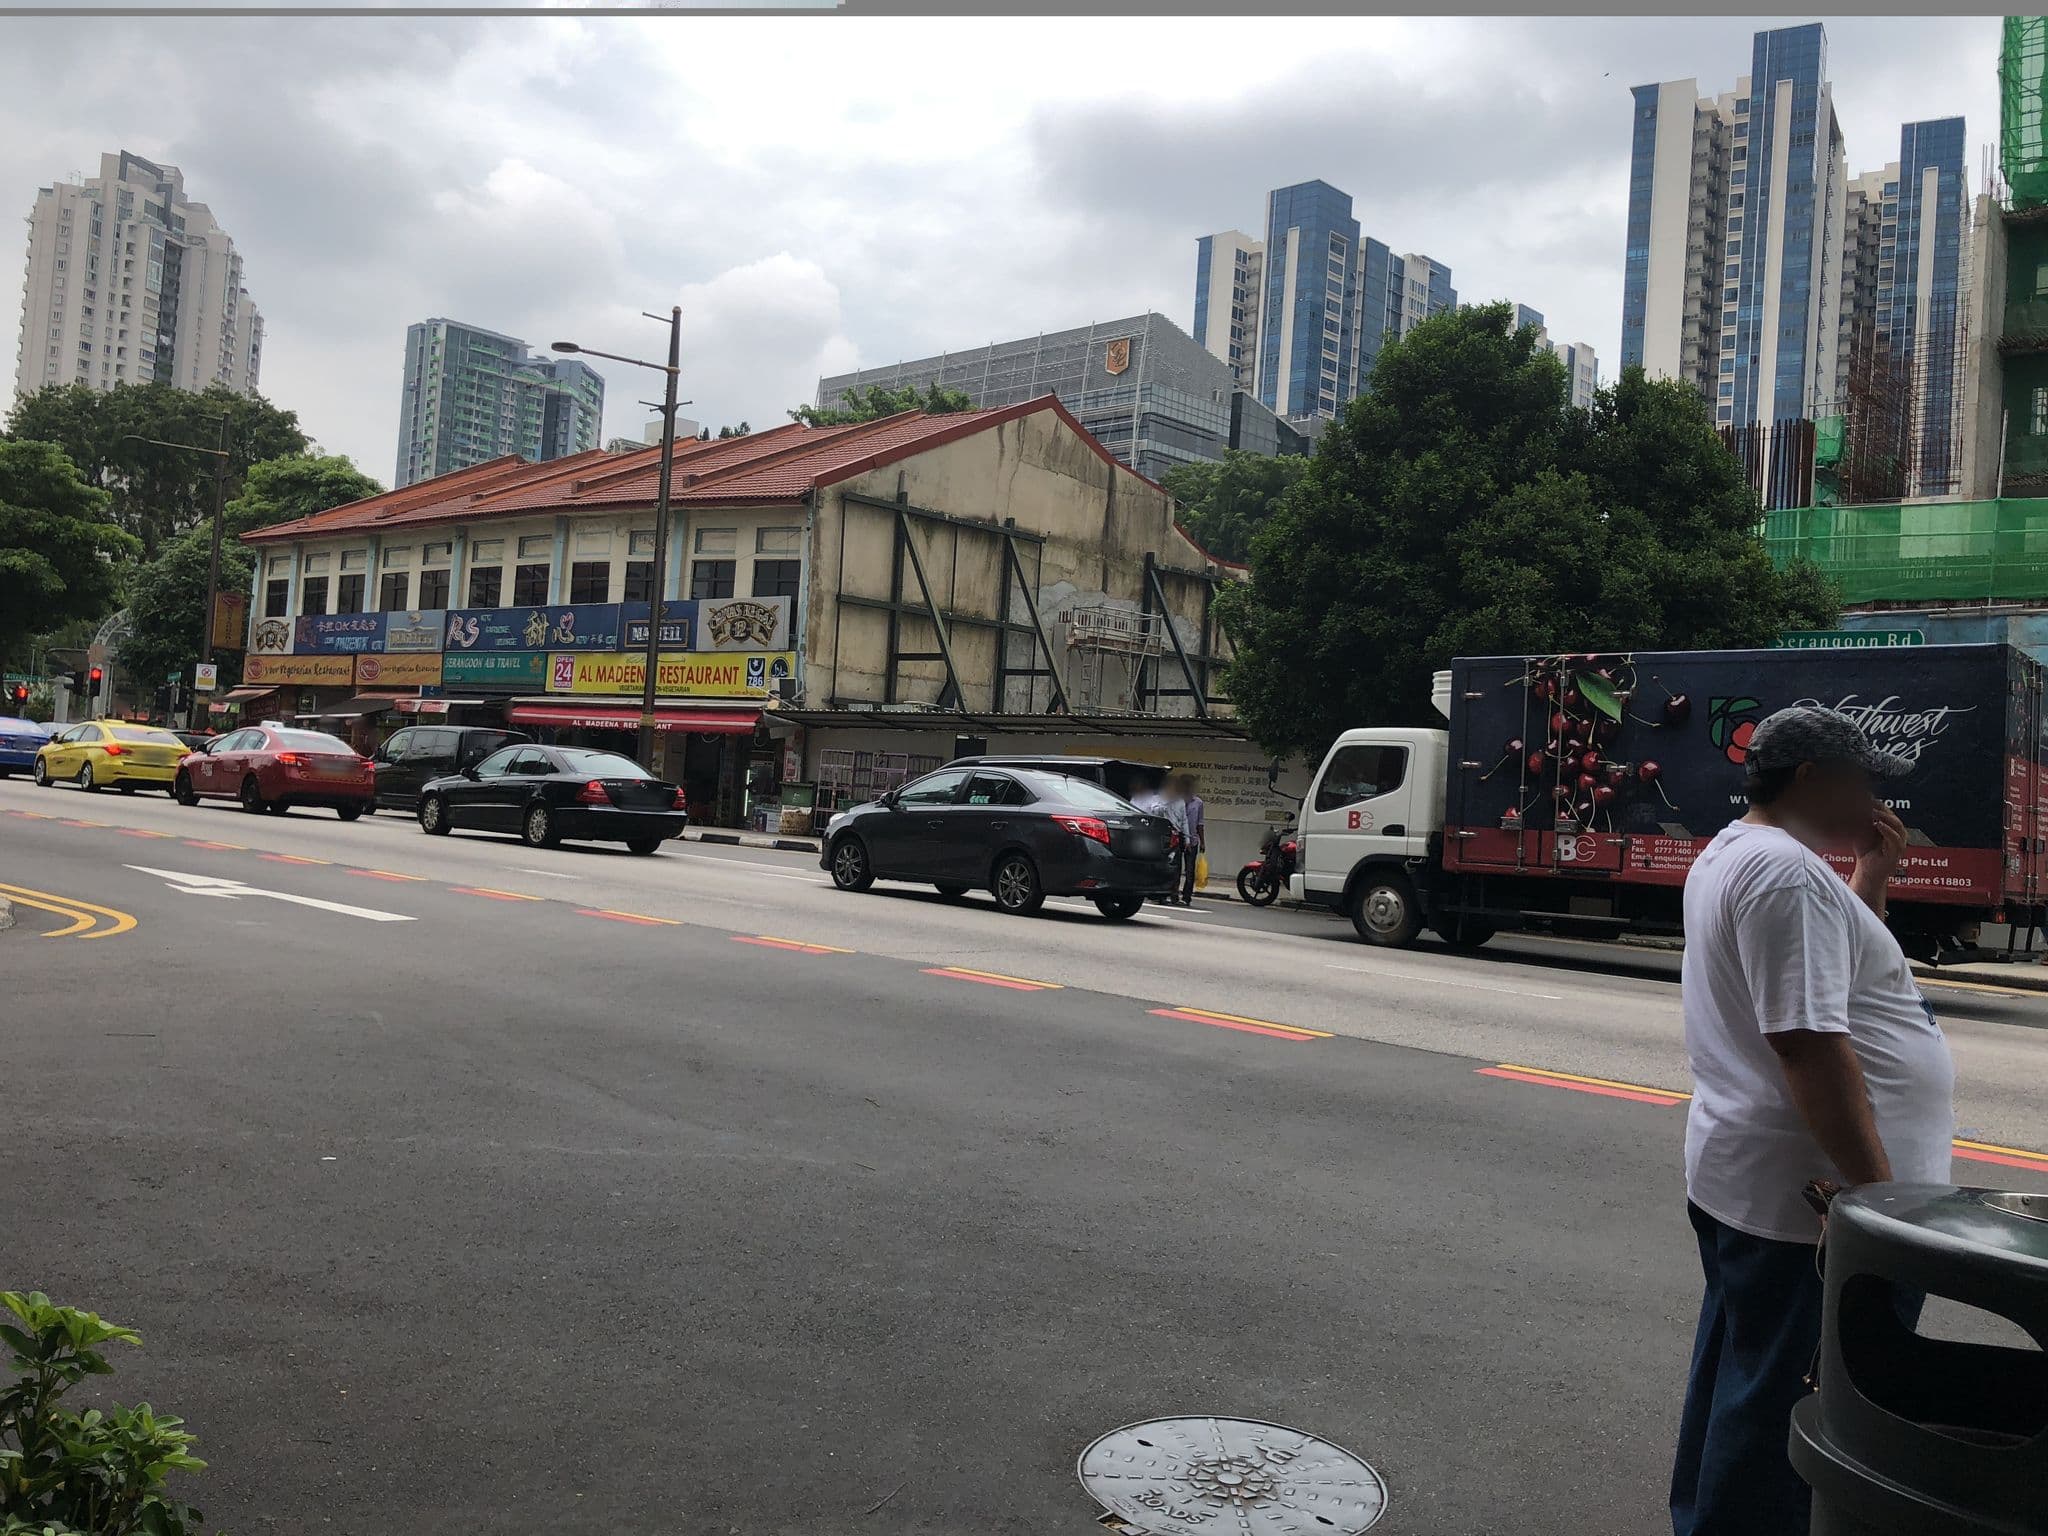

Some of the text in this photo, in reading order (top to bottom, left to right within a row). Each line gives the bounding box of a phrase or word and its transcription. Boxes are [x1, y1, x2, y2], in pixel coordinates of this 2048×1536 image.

[632, 626, 682, 641] MATELL
[1775, 632, 1912, 648] Serangoon Rd
[445, 657, 482, 669] SERANGOON
[496, 657, 521, 668] TRAVEL
[556, 663, 572, 680] 24
[579, 665, 740, 685] AL MADEEN RESTAURANT
[747, 676, 763, 687] 786
[585, 720, 619, 728] MADEENA
[623, 722, 672, 730] RESANT
[1230, 764, 1252, 772] Family
[1348, 810, 1374, 830] BC
[1558, 834, 1597, 862] BC
[1655, 839, 1672, 847] 6777
[1822, 853, 1854, 863] Choon
[1911, 857, 1928, 866] Pte
[1930, 857, 1949, 867] Ltd
[1888, 875, 1972, 888] ngapore 618803
[1130, 1493, 1206, 1525] ROADS
